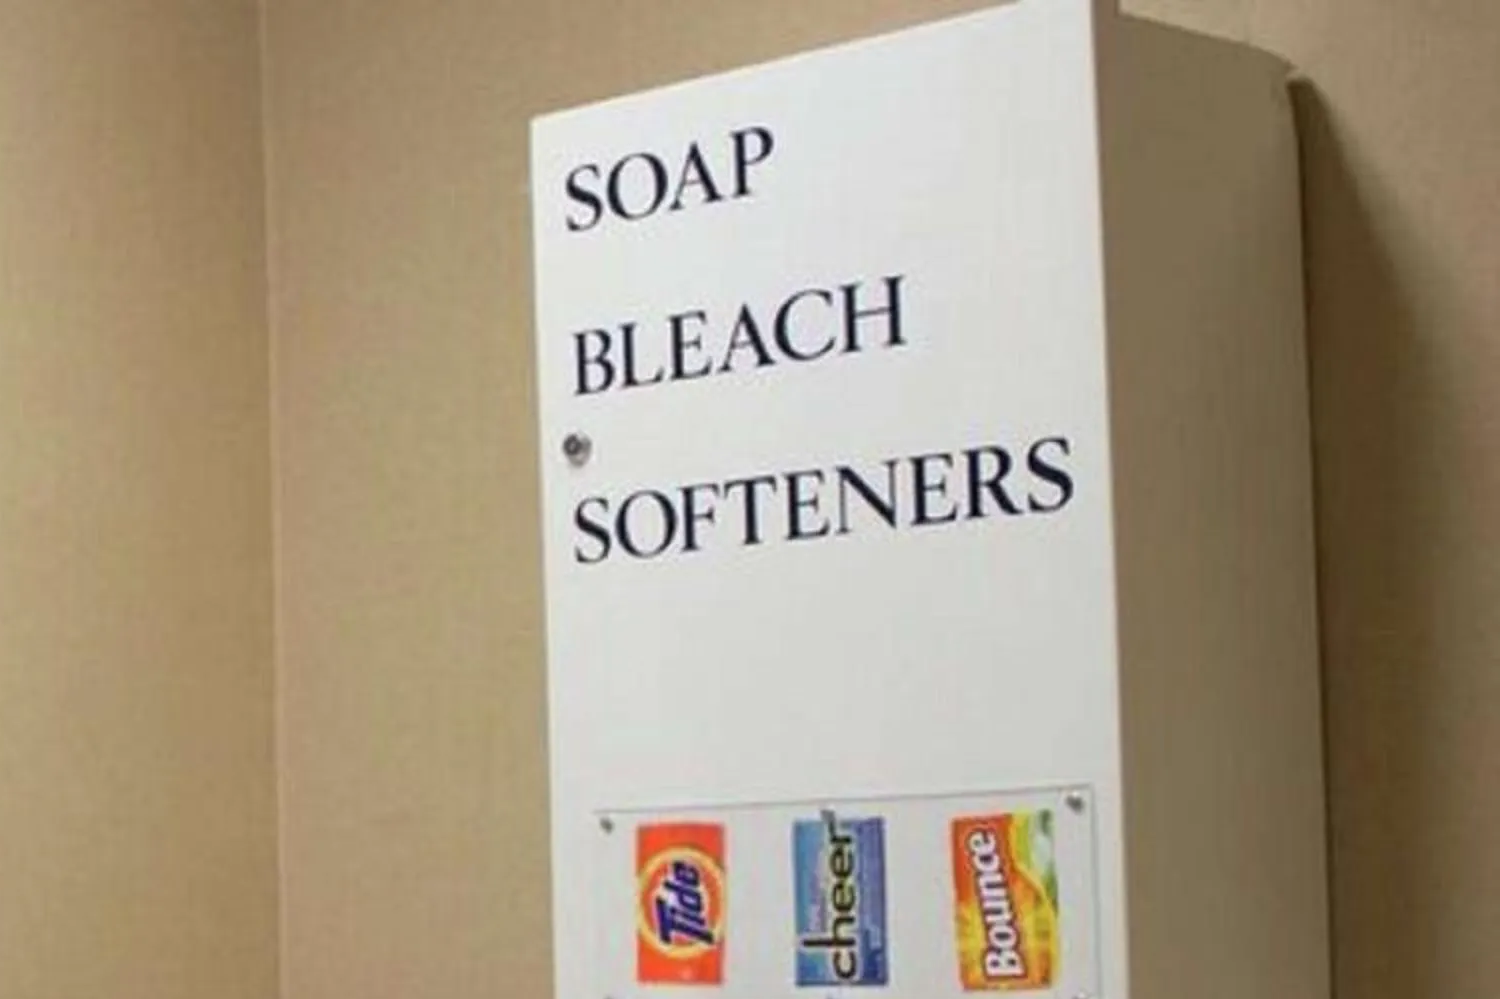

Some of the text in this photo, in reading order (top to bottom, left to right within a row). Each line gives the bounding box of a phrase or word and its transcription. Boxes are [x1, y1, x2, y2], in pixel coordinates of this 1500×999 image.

[564, 126, 775, 233] SOAP
[573, 275, 907, 396] BLEACH
[574, 437, 1075, 565] SOFTENERS
[655, 860, 714, 945] Tide
[801, 810, 856, 980] cheer
[968, 830, 1026, 976] Bounce
